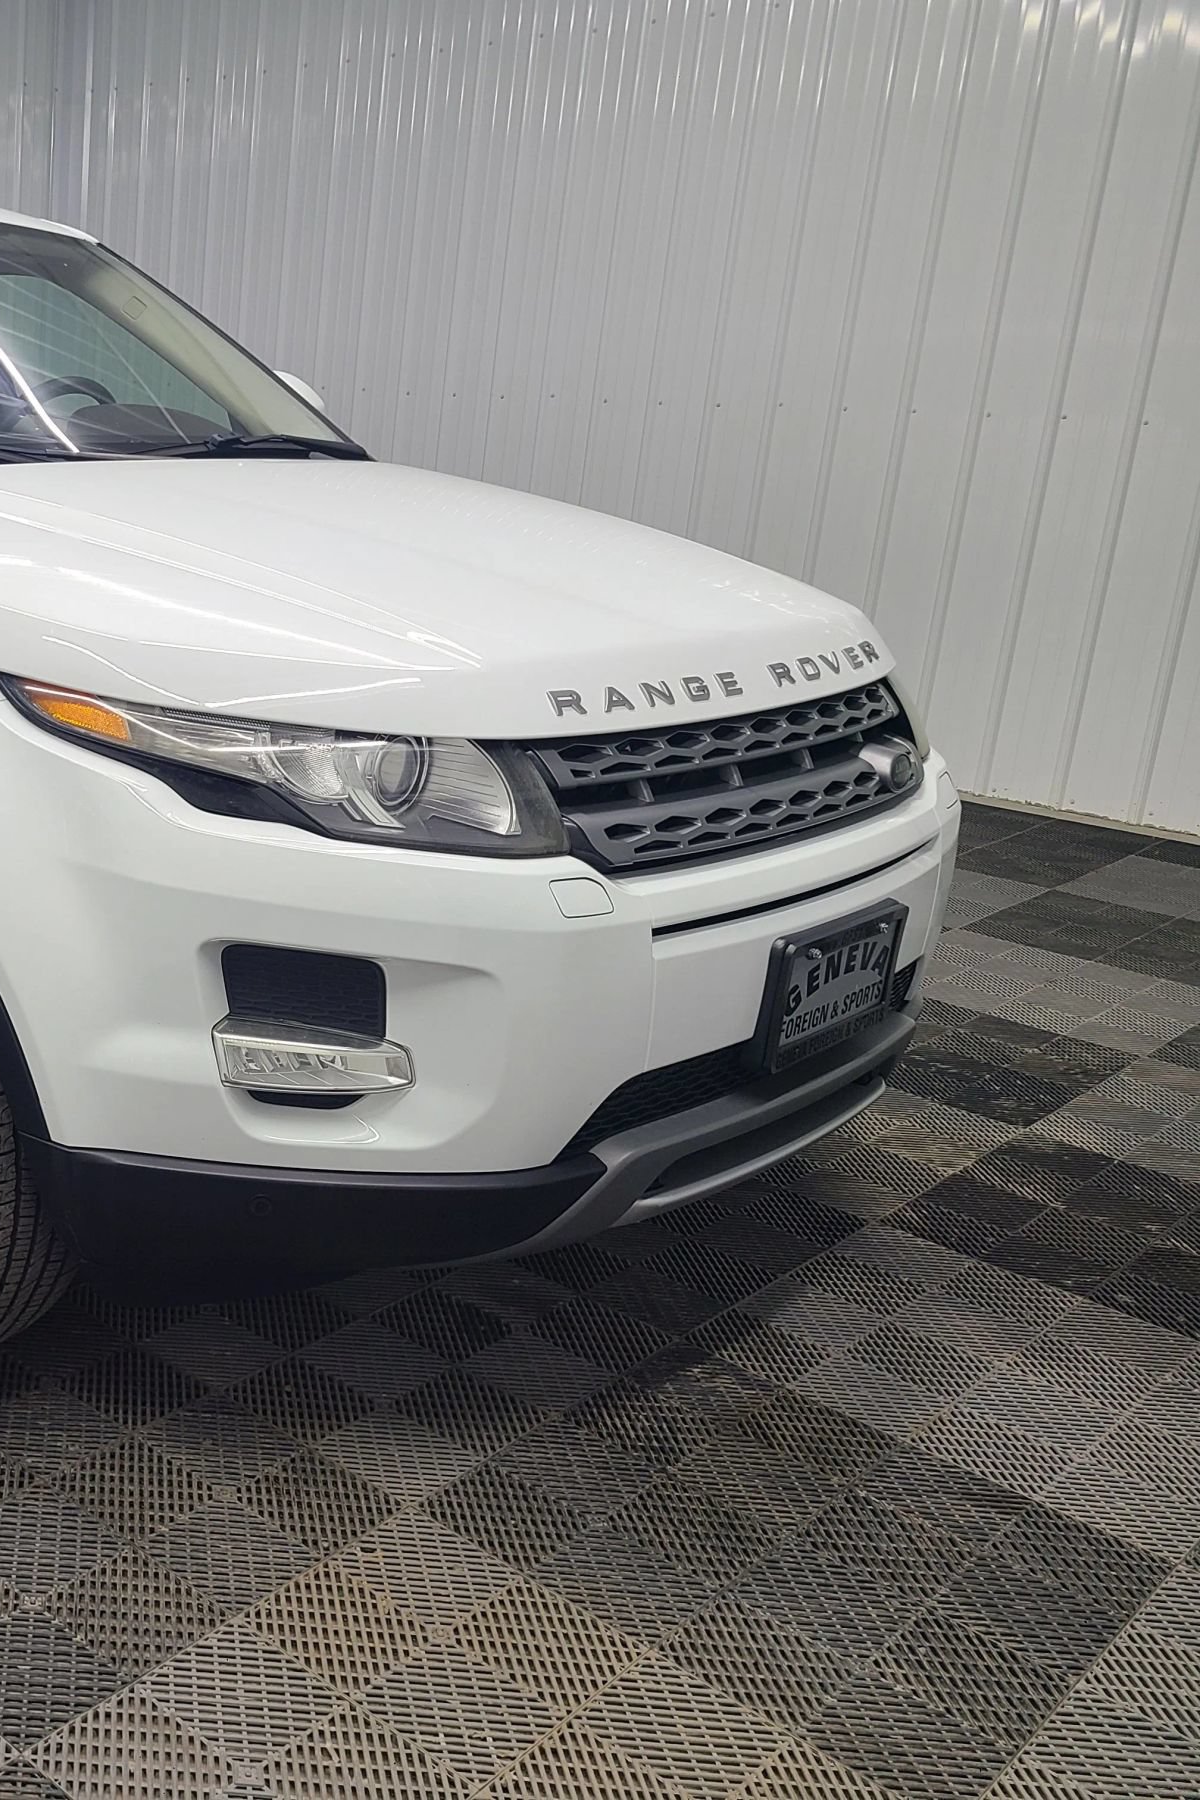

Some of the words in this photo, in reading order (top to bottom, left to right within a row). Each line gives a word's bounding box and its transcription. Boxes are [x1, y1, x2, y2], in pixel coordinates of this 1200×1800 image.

[546, 671, 743, 716] RANGE
[766, 640, 880, 688] ROVER
[781, 1003, 829, 1040] FOREIGN
[830, 1000, 840, 1020] &
[841, 980, 883, 1015] SPORTS
[784, 941, 890, 1018] GENEVA
